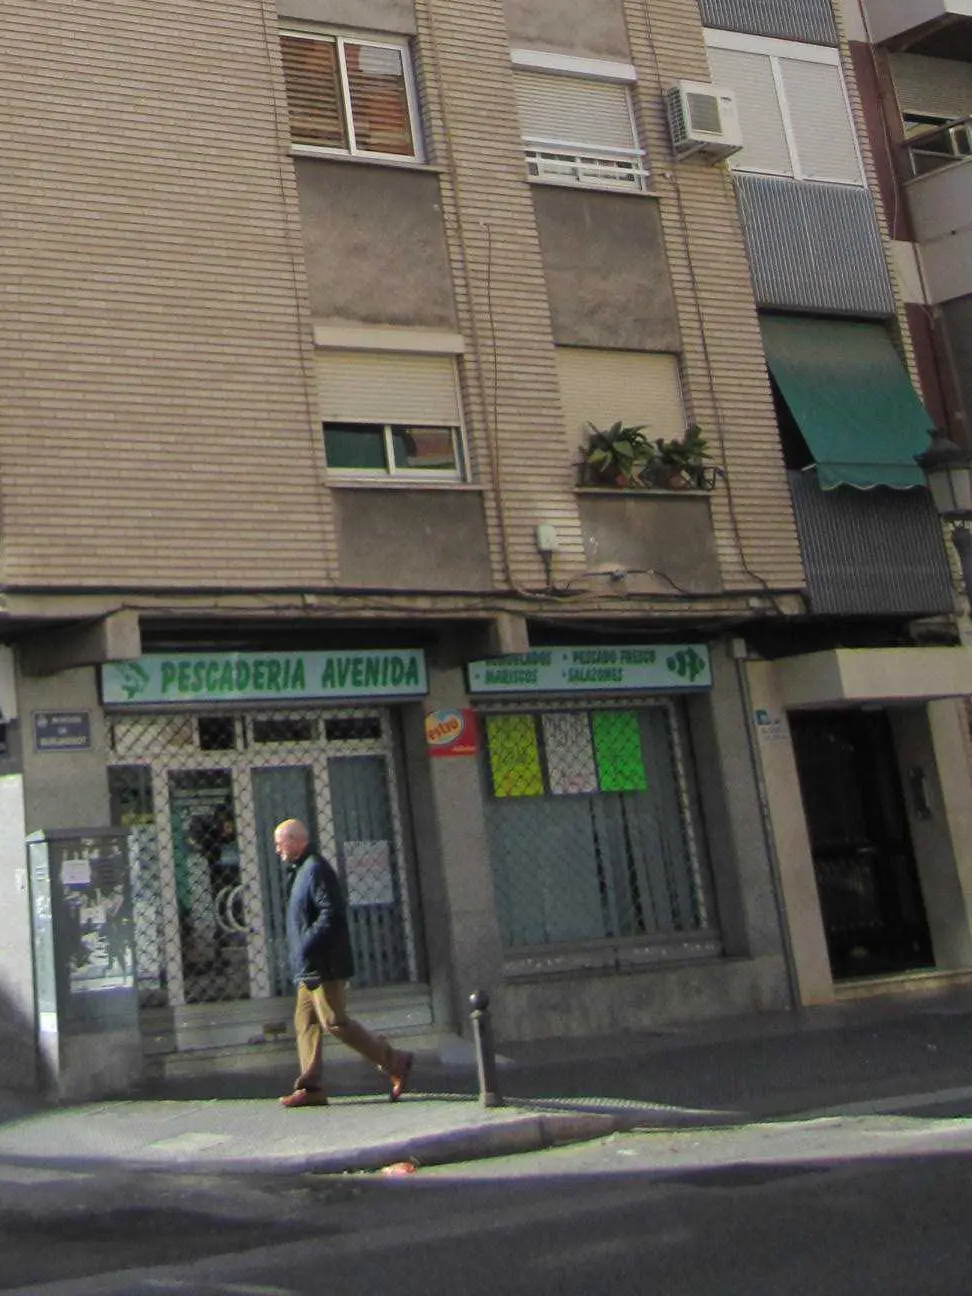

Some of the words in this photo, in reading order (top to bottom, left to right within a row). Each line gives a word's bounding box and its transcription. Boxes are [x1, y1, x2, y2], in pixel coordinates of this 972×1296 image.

[573, 650, 617, 664] PESCADO
[620, 649, 656, 664] FRESCO
[160, 658, 305, 693] PESCADERIA
[321, 656, 419, 688] AVENIDA
[485, 668, 538, 684] MARISCOS
[568, 667, 623, 683] SALAZONES
